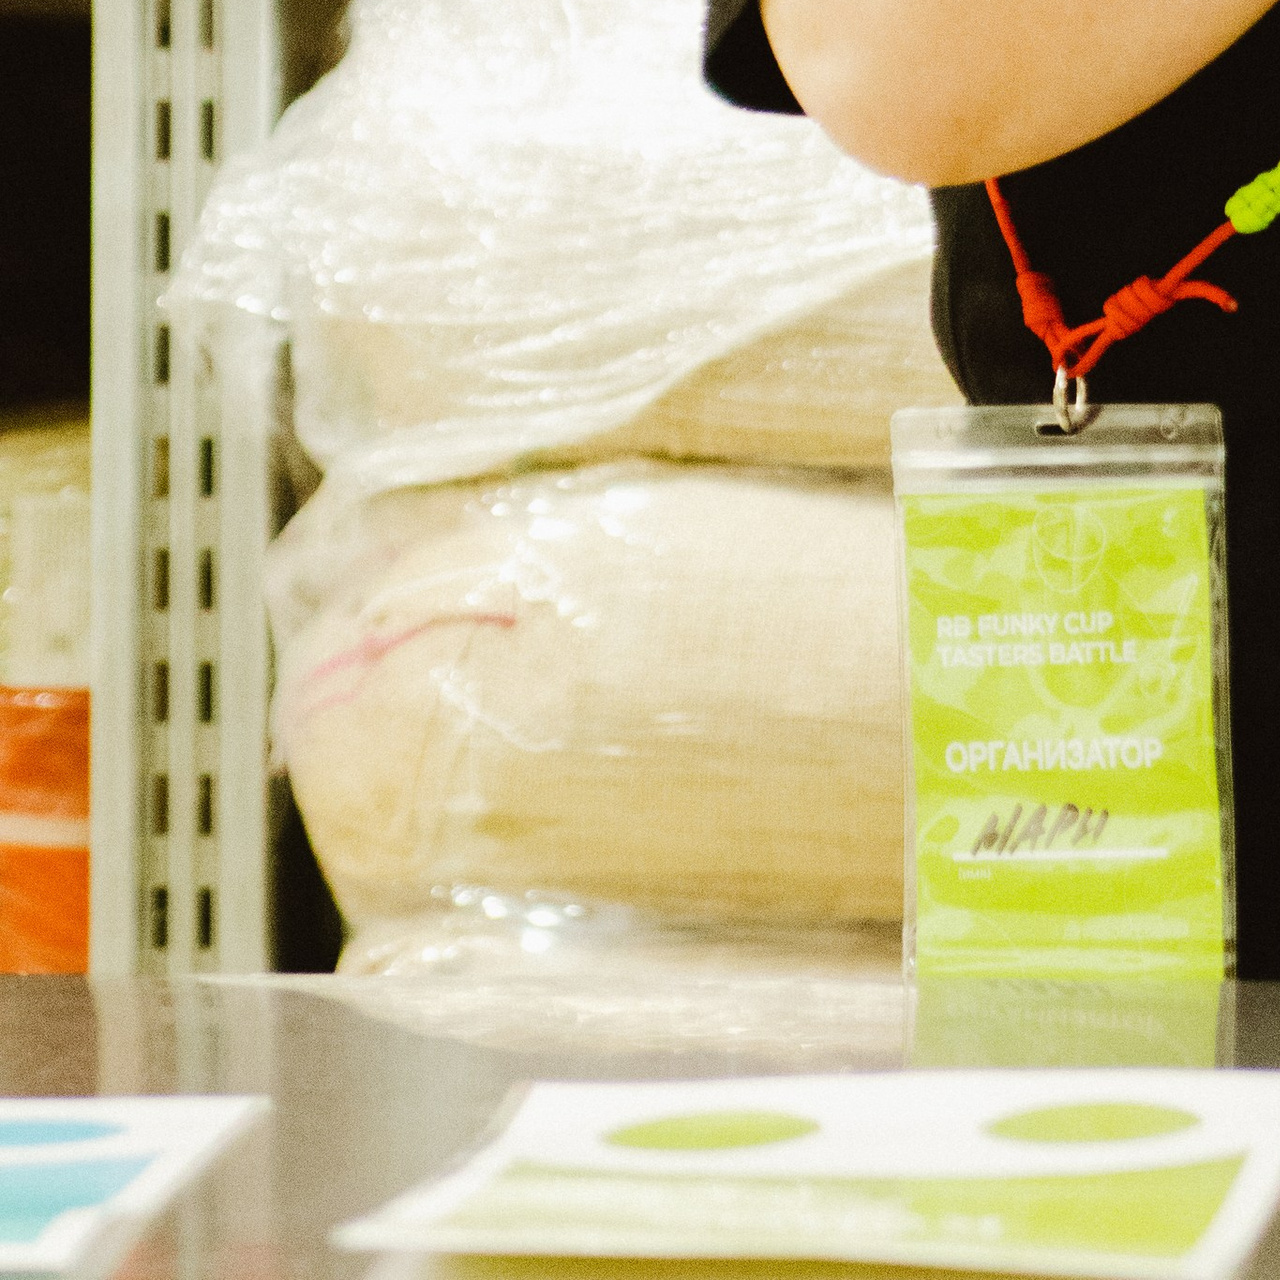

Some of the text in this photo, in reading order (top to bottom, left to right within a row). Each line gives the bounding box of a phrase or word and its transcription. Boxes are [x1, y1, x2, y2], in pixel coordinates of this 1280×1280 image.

[936, 611, 1114, 639] RB FUNKY CUP
[936, 640, 1139, 668] TASTERS BATTLE
[946, 739, 1164, 772] ОРГАНИЗАТОР
